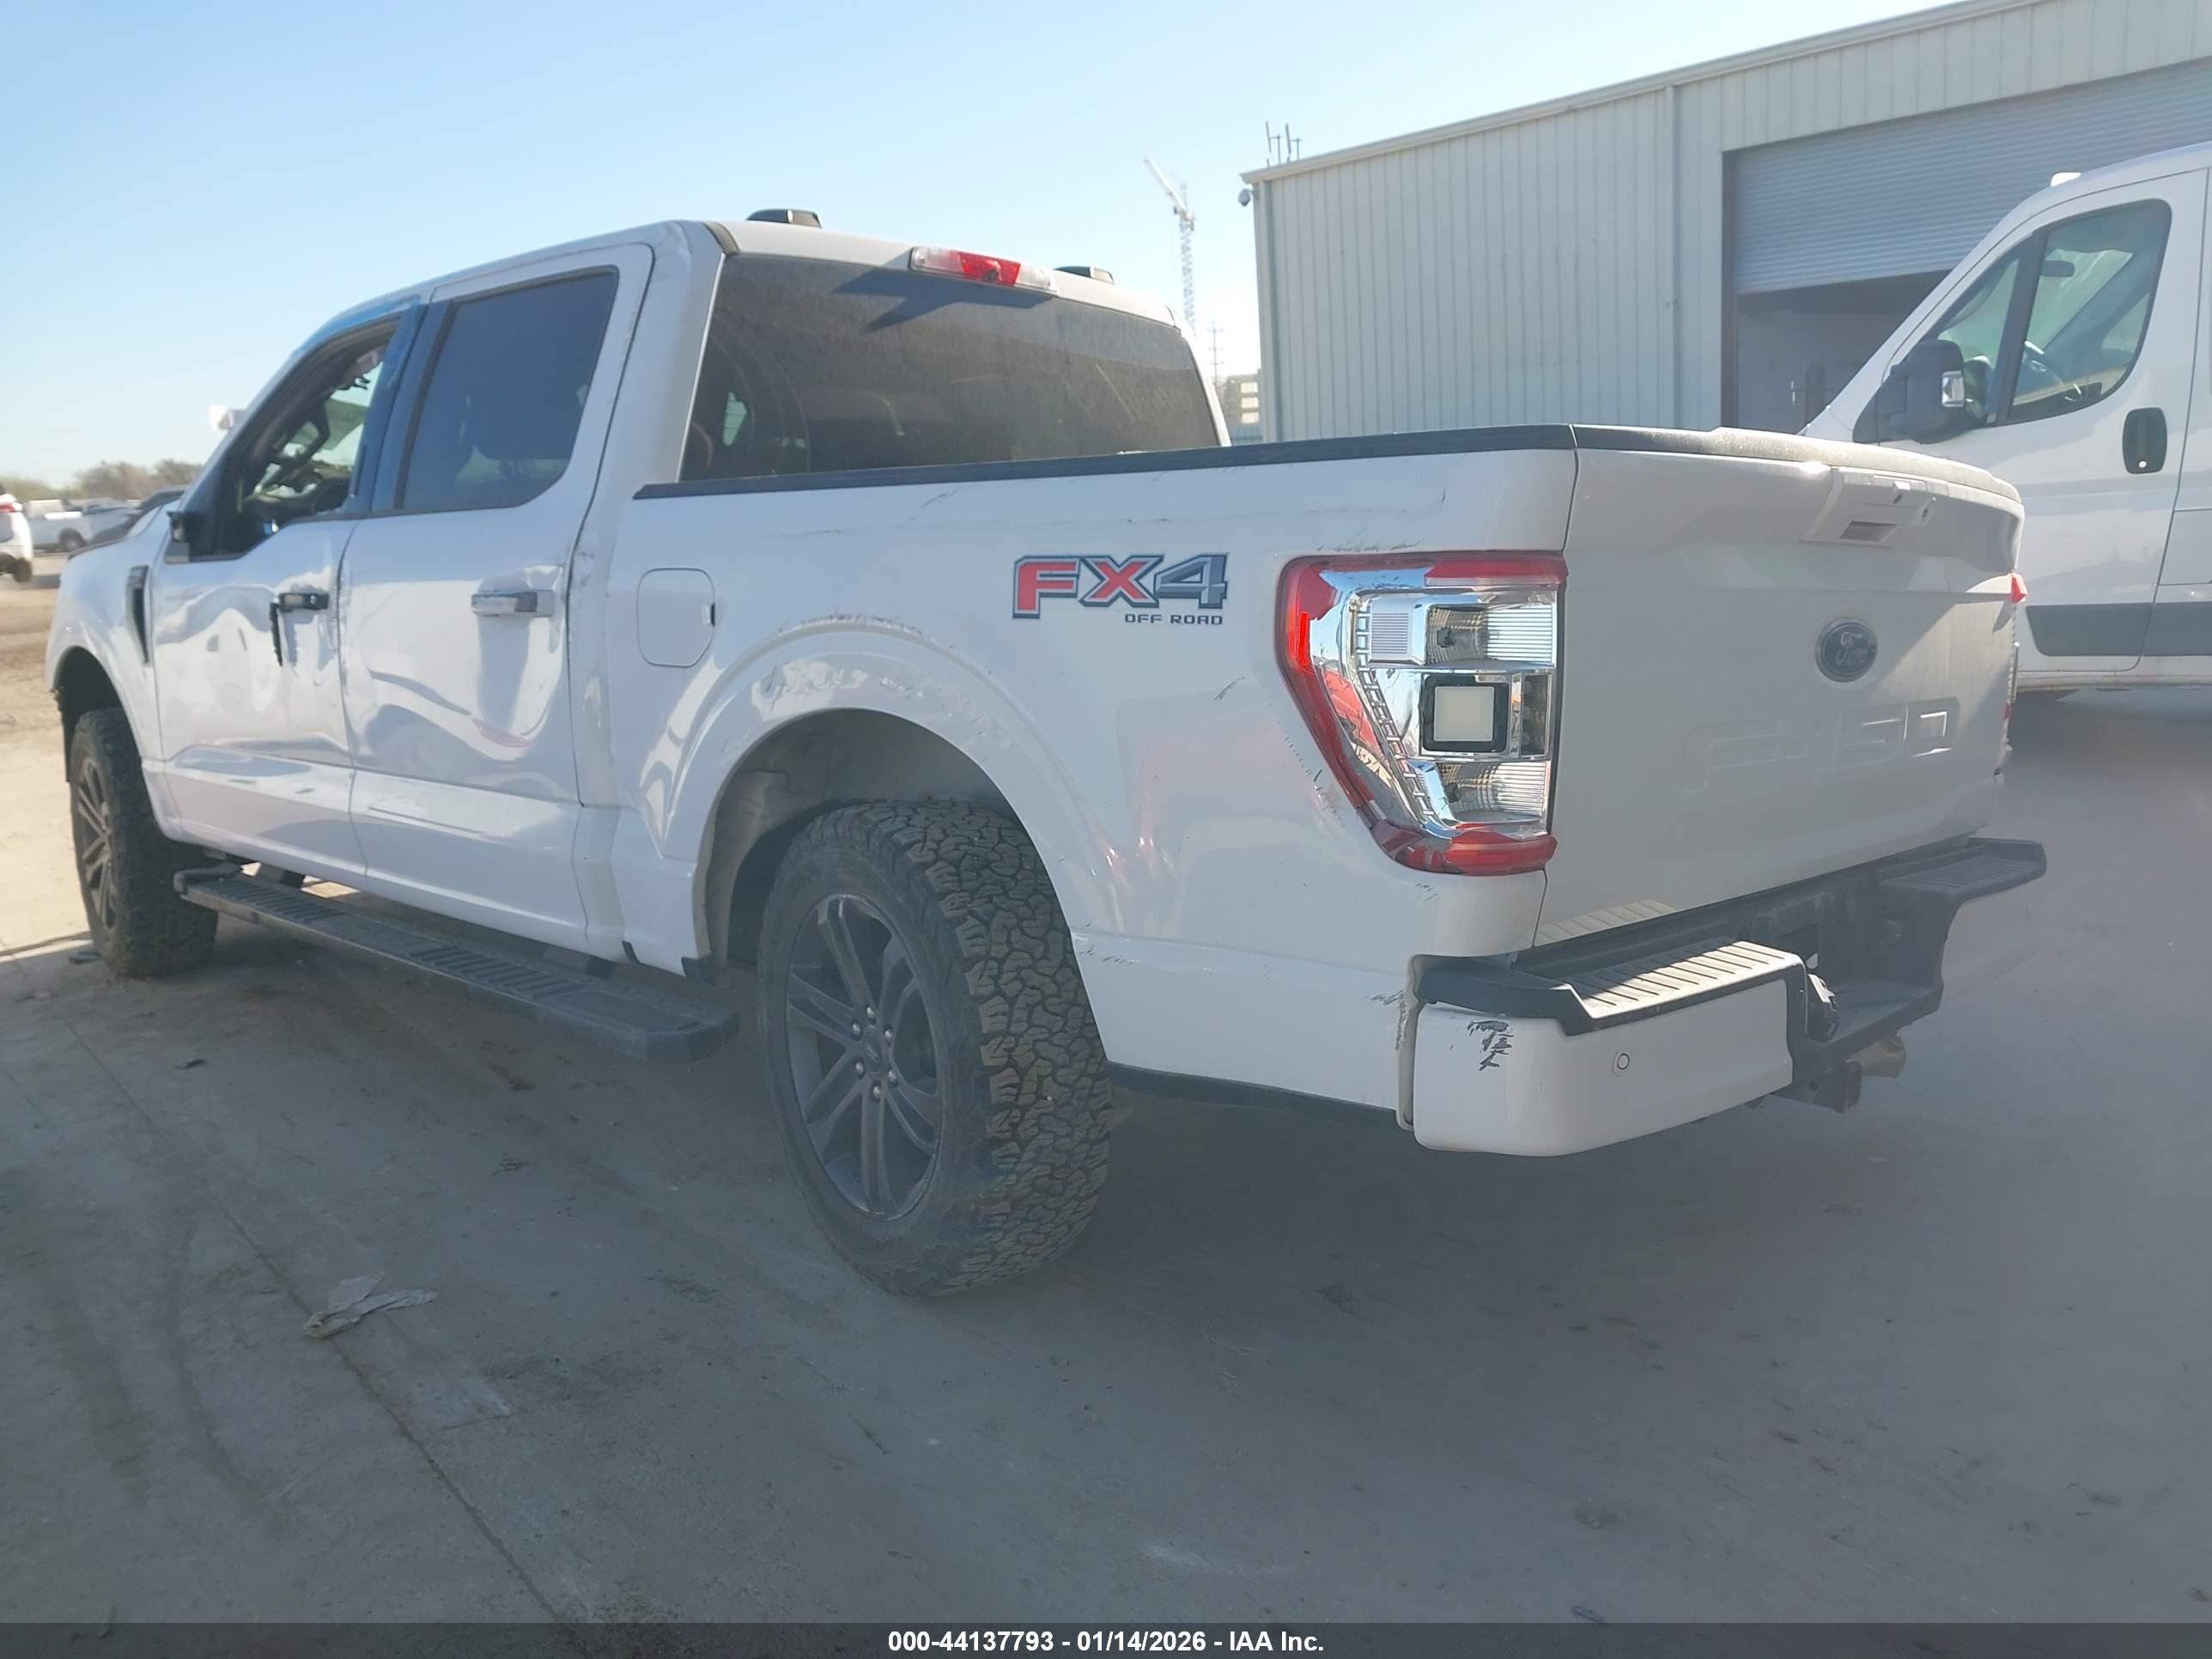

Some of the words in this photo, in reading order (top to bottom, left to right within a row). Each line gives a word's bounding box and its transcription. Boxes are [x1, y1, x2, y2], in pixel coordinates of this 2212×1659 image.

[1012, 553, 1230, 619] FX4
[1125, 613, 1162, 623] OFF
[1170, 614, 1224, 626] ROAD
